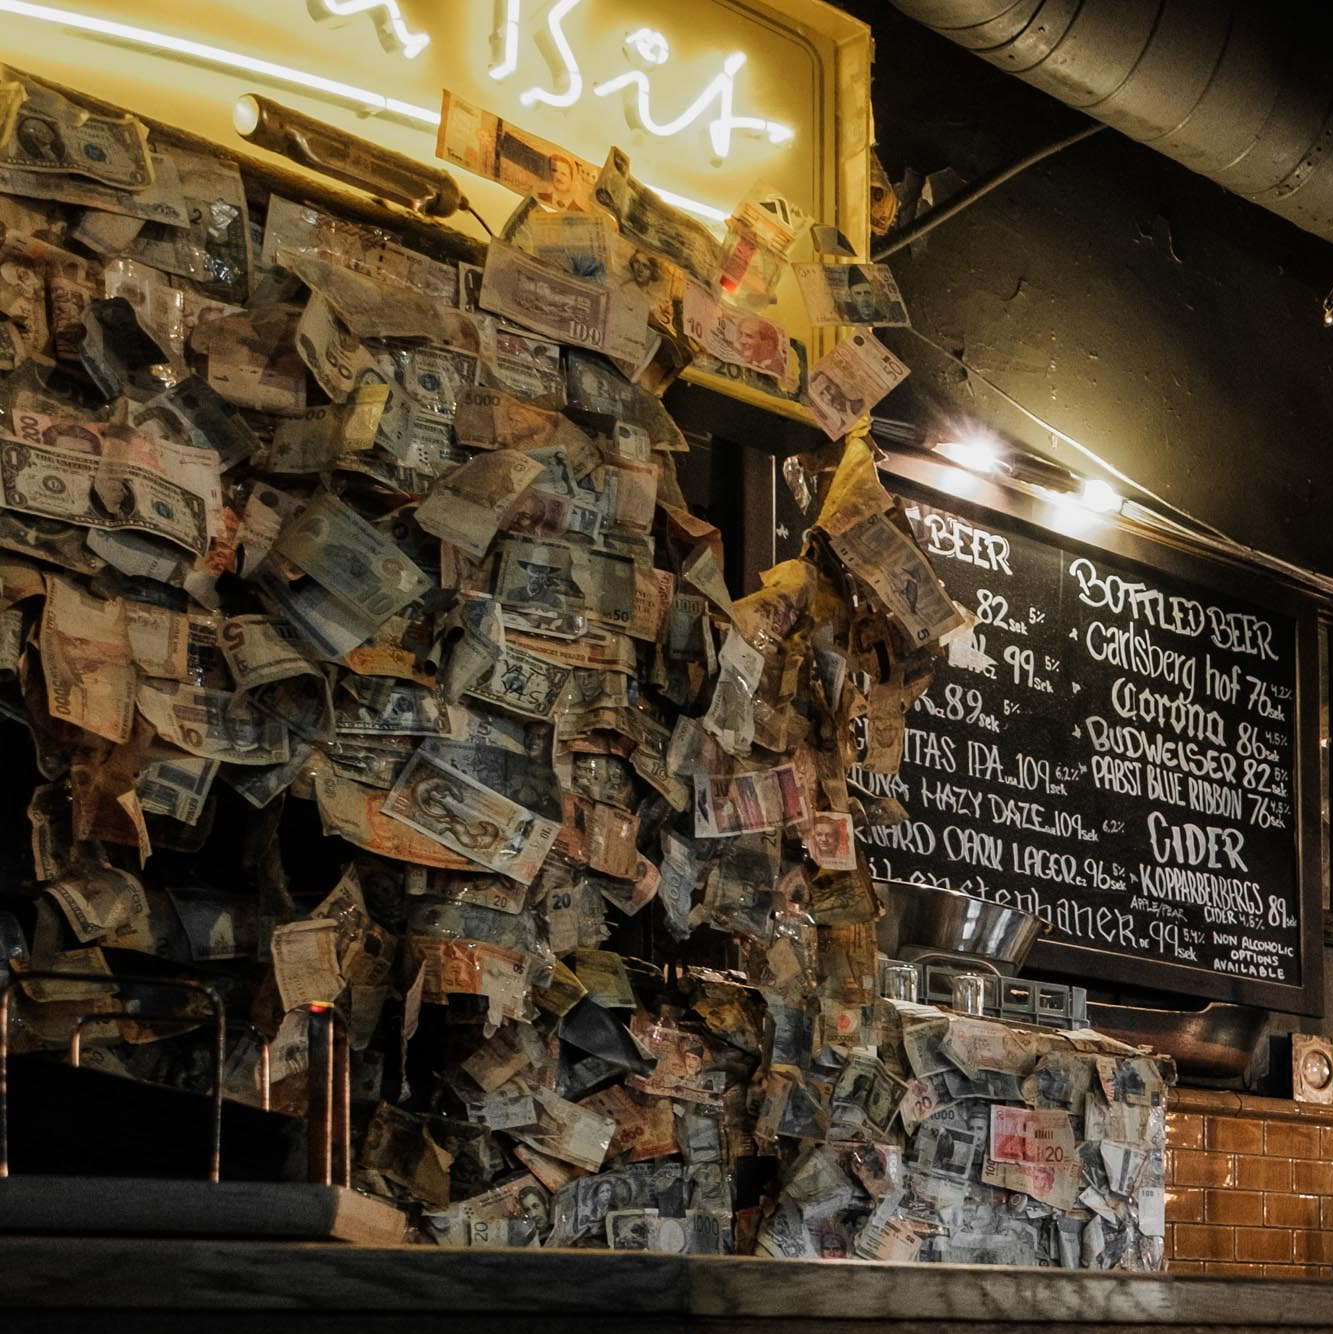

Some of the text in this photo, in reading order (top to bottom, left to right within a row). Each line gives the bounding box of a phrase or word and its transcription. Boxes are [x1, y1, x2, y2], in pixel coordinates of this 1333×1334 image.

[883, 361, 904, 381] 50
[925, 514, 1013, 576] BEER
[613, 608, 629, 622] 50
[976, 589, 1046, 636] 82 sek 5%
[1069, 558, 1279, 661] BOTTLED BEER
[917, 628, 930, 642] 5
[1003, 645, 1035, 688] 99
[1034, 677, 1054, 693] sek
[1045, 655, 1061, 672] 5%
[1086, 621, 1196, 704] Carlsberg
[1206, 653, 1242, 704] hof
[1246, 675, 1272, 717] 76
[944, 683, 983, 724] 89
[979, 713, 1000, 734] sek
[1111, 677, 1227, 748] Corona
[1236, 722, 1266, 760] 86
[967, 740, 1003, 782] IPA
[1015, 752, 1050, 794] 109
[1085, 716, 1238, 784] BUDWEISER
[1242, 758, 1272, 793] 82
[921, 776, 983, 818] HAZY
[987, 793, 1045, 834] DAZE
[1054, 811, 1082, 838] 109
[1081, 829, 1100, 842] sek
[1091, 755, 1143, 797] PABST
[1147, 764, 1187, 807] BLUE
[1188, 775, 1243, 820] RIBBON
[1247, 793, 1272, 829] 76
[1146, 810, 1249, 873] CIDER
[1012, 842, 1076, 885] LAGER
[1084, 858, 1110, 890] 96
[1112, 862, 1126, 877] 5%
[551, 894, 571, 910] 20
[1110, 880, 1127, 891] sek
[1203, 904, 1238, 925] CIDER
[1267, 894, 1288, 929] 89
[1149, 921, 1180, 957] 99
[1177, 946, 1198, 962] sek
[1212, 931, 1295, 958] NON ALCOHOLIC
[1230, 949, 1280, 967] OPTIONS
[1213, 957, 1286, 981] AVAILABLE
[915, 1096, 933, 1114] 20
[1045, 1146, 1065, 1162] 20
[474, 1221, 489, 1243] 20
